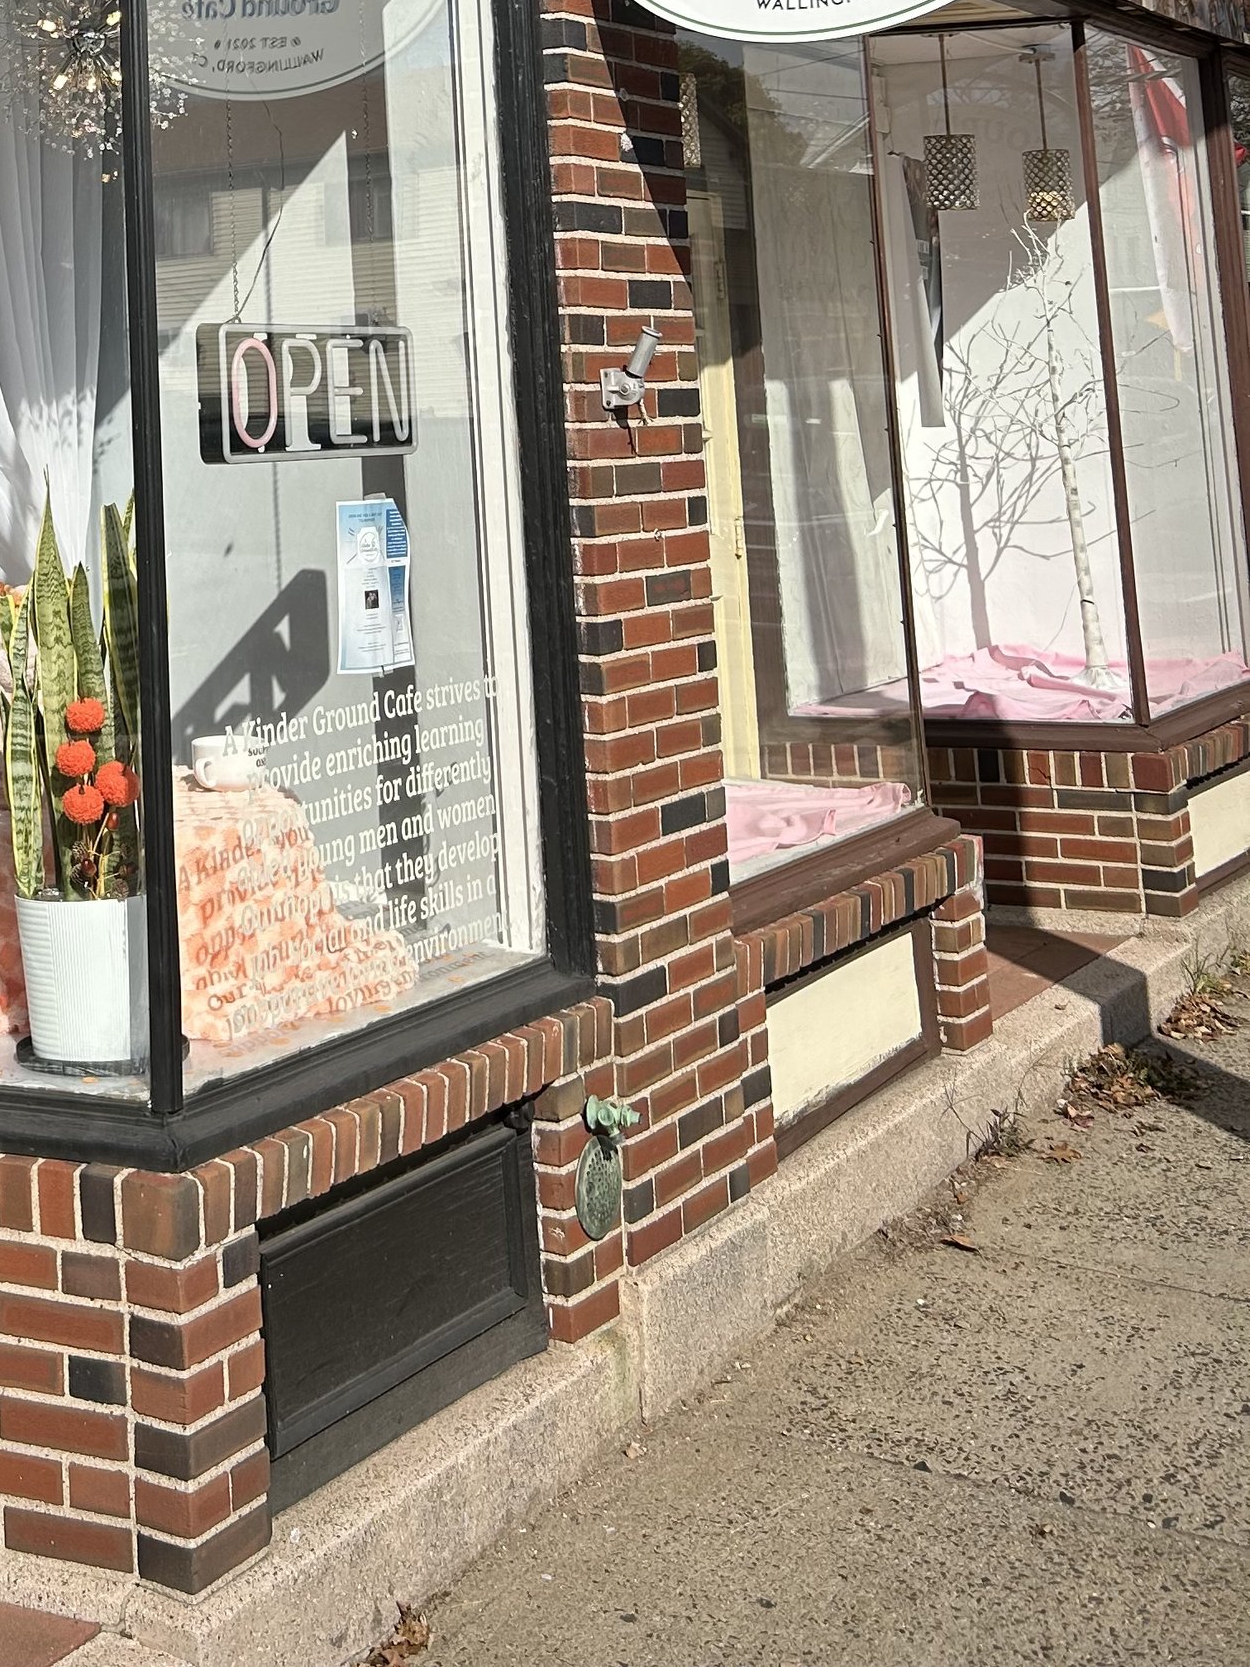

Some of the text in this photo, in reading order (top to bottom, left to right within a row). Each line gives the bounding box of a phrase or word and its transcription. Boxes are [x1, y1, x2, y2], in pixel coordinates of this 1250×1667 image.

[231, 337, 410, 452] OPEN
[223, 725, 239, 757] A
[241, 711, 309, 753] Kinder
[312, 690, 382, 736] Ground
[383, 684, 423, 720] Cafe
[426, 676, 482, 709] strives
[325, 727, 413, 777] enriching
[414, 716, 485, 756] learning
[375, 774, 403, 806] for
[405, 754, 492, 796] differently
[359, 822, 399, 855] men
[402, 805, 435, 841] and
[436, 793, 498, 832] women
[354, 864, 393, 900] that
[396, 845, 436, 886] they
[437, 829, 500, 875] develop
[388, 895, 417, 930] life
[419, 880, 464, 918] skills
[466, 874, 484, 902] in
